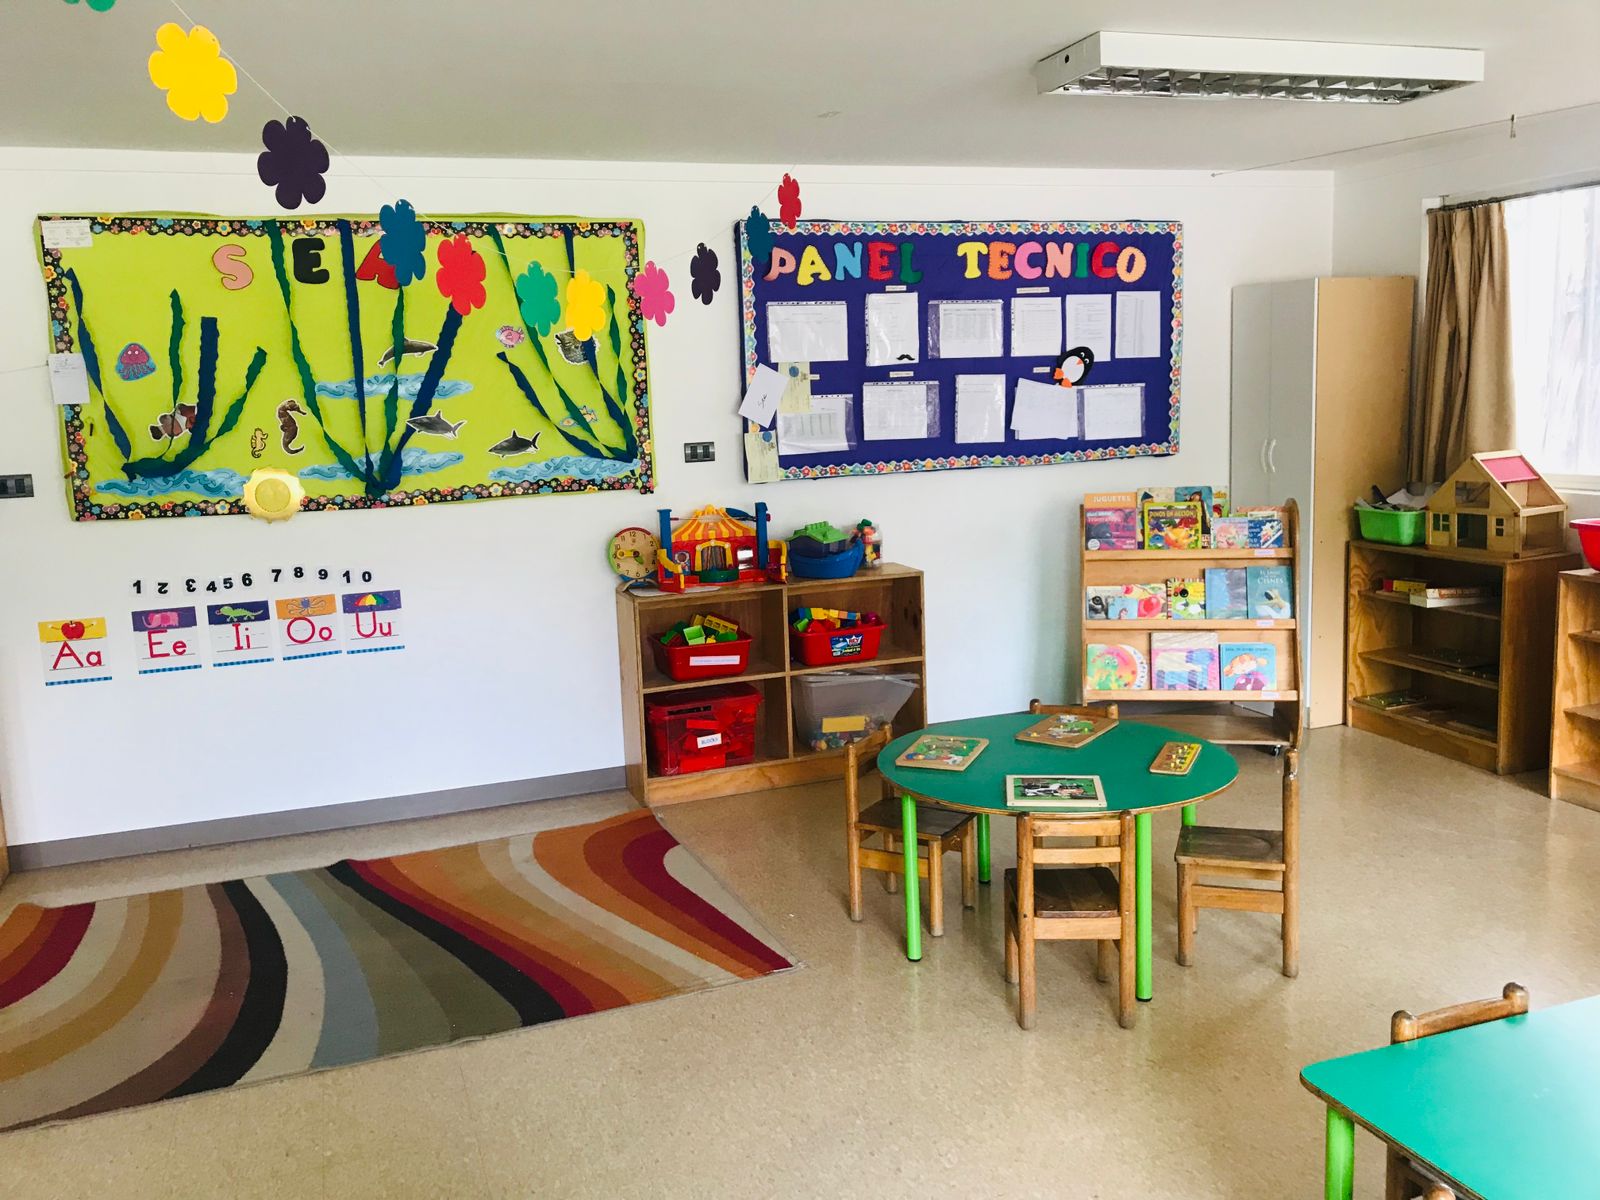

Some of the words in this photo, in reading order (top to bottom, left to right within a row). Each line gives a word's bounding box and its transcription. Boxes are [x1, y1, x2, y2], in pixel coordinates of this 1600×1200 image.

[763, 240, 924, 286] PANEL
[957, 241, 1148, 283] TECNICO
[133, 580, 142, 593] 1
[206, 580, 218, 592] 4
[223, 577, 234, 589] 5
[241, 573, 253, 586] 6
[271, 569, 282, 582] 7
[293, 566, 304, 578] 8
[317, 569, 329, 580] 9
[232, 623, 251, 650] Ii
[287, 617, 333, 644] Oo
[356, 612, 392, 638] Uu
[53, 641, 103, 670] Aa
[148, 629, 187, 658] Ee
